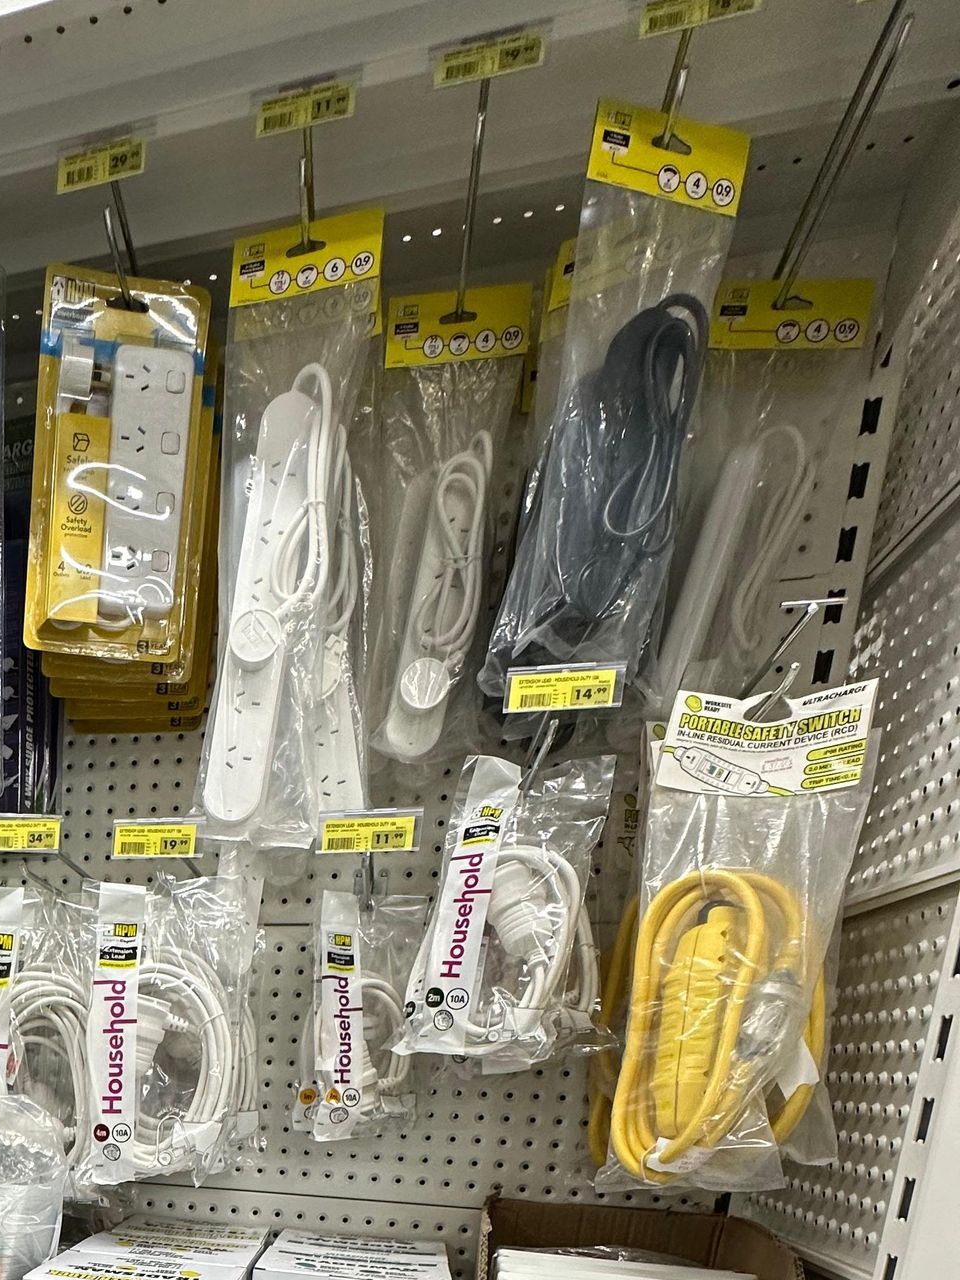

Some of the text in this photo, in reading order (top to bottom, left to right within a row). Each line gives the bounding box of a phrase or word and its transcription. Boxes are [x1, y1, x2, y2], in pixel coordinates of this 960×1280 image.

[693, 178, 731, 197] 4 0.9
[332, 255, 370, 273] 6 0.9
[838, 323, 855, 333] 0.9
[483, 331, 519, 343] 4 0.9
[66, 516, 88, 526] Safety
[60, 524, 92, 534] Overload
[58, 561, 66, 572] 4
[574, 687, 607, 700] 14.99
[802, 684, 868, 707] ULTRACHARGE
[705, 700, 732, 709] WORKSITE
[678, 708, 862, 740] PORTABLE SAFETY SWITCH
[677, 730, 705, 742] IN-LINE
[706, 735, 745, 749] RESIDUAL
[747, 739, 792, 750] CURRENT
[794, 731, 829, 746] DEVICE
[831, 723, 858, 737] (RCD)
[29, 833, 52, 843] 34.99
[376, 833, 403, 844] 11.99
[163, 840, 188, 849] 19.99
[439, 851, 493, 979] Household
[115, 925, 137, 937] HPM
[336, 934, 352, 947] HPM
[427, 993, 466, 1004] 2m 10A
[322, 974, 363, 1084] Household
[93, 980, 138, 1114] Household
[345, 1093, 357, 1102] 10A
[96, 1129, 129, 1138] 4m 10A
